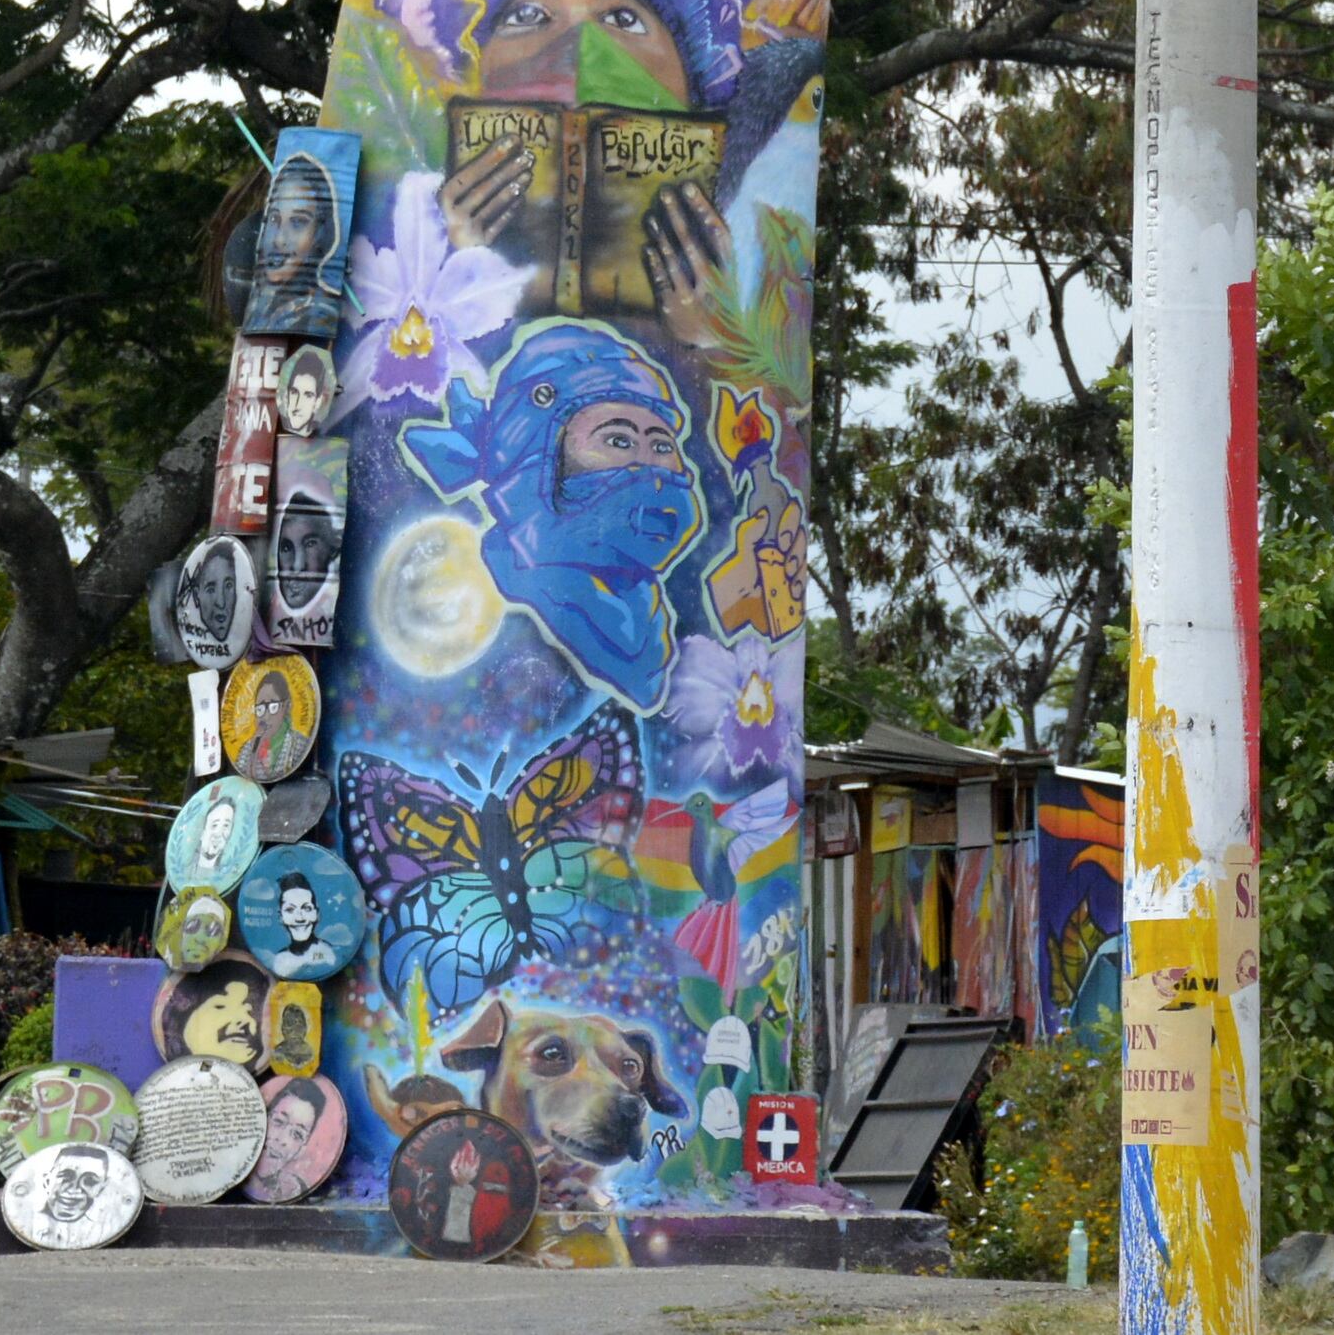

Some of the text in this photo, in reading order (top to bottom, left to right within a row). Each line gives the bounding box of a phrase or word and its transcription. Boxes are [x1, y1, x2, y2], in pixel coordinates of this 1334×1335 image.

[463, 111, 551, 149] LUCHA
[758, 1100, 796, 1109] MISION
[756, 1160, 806, 1174] MEDICA
